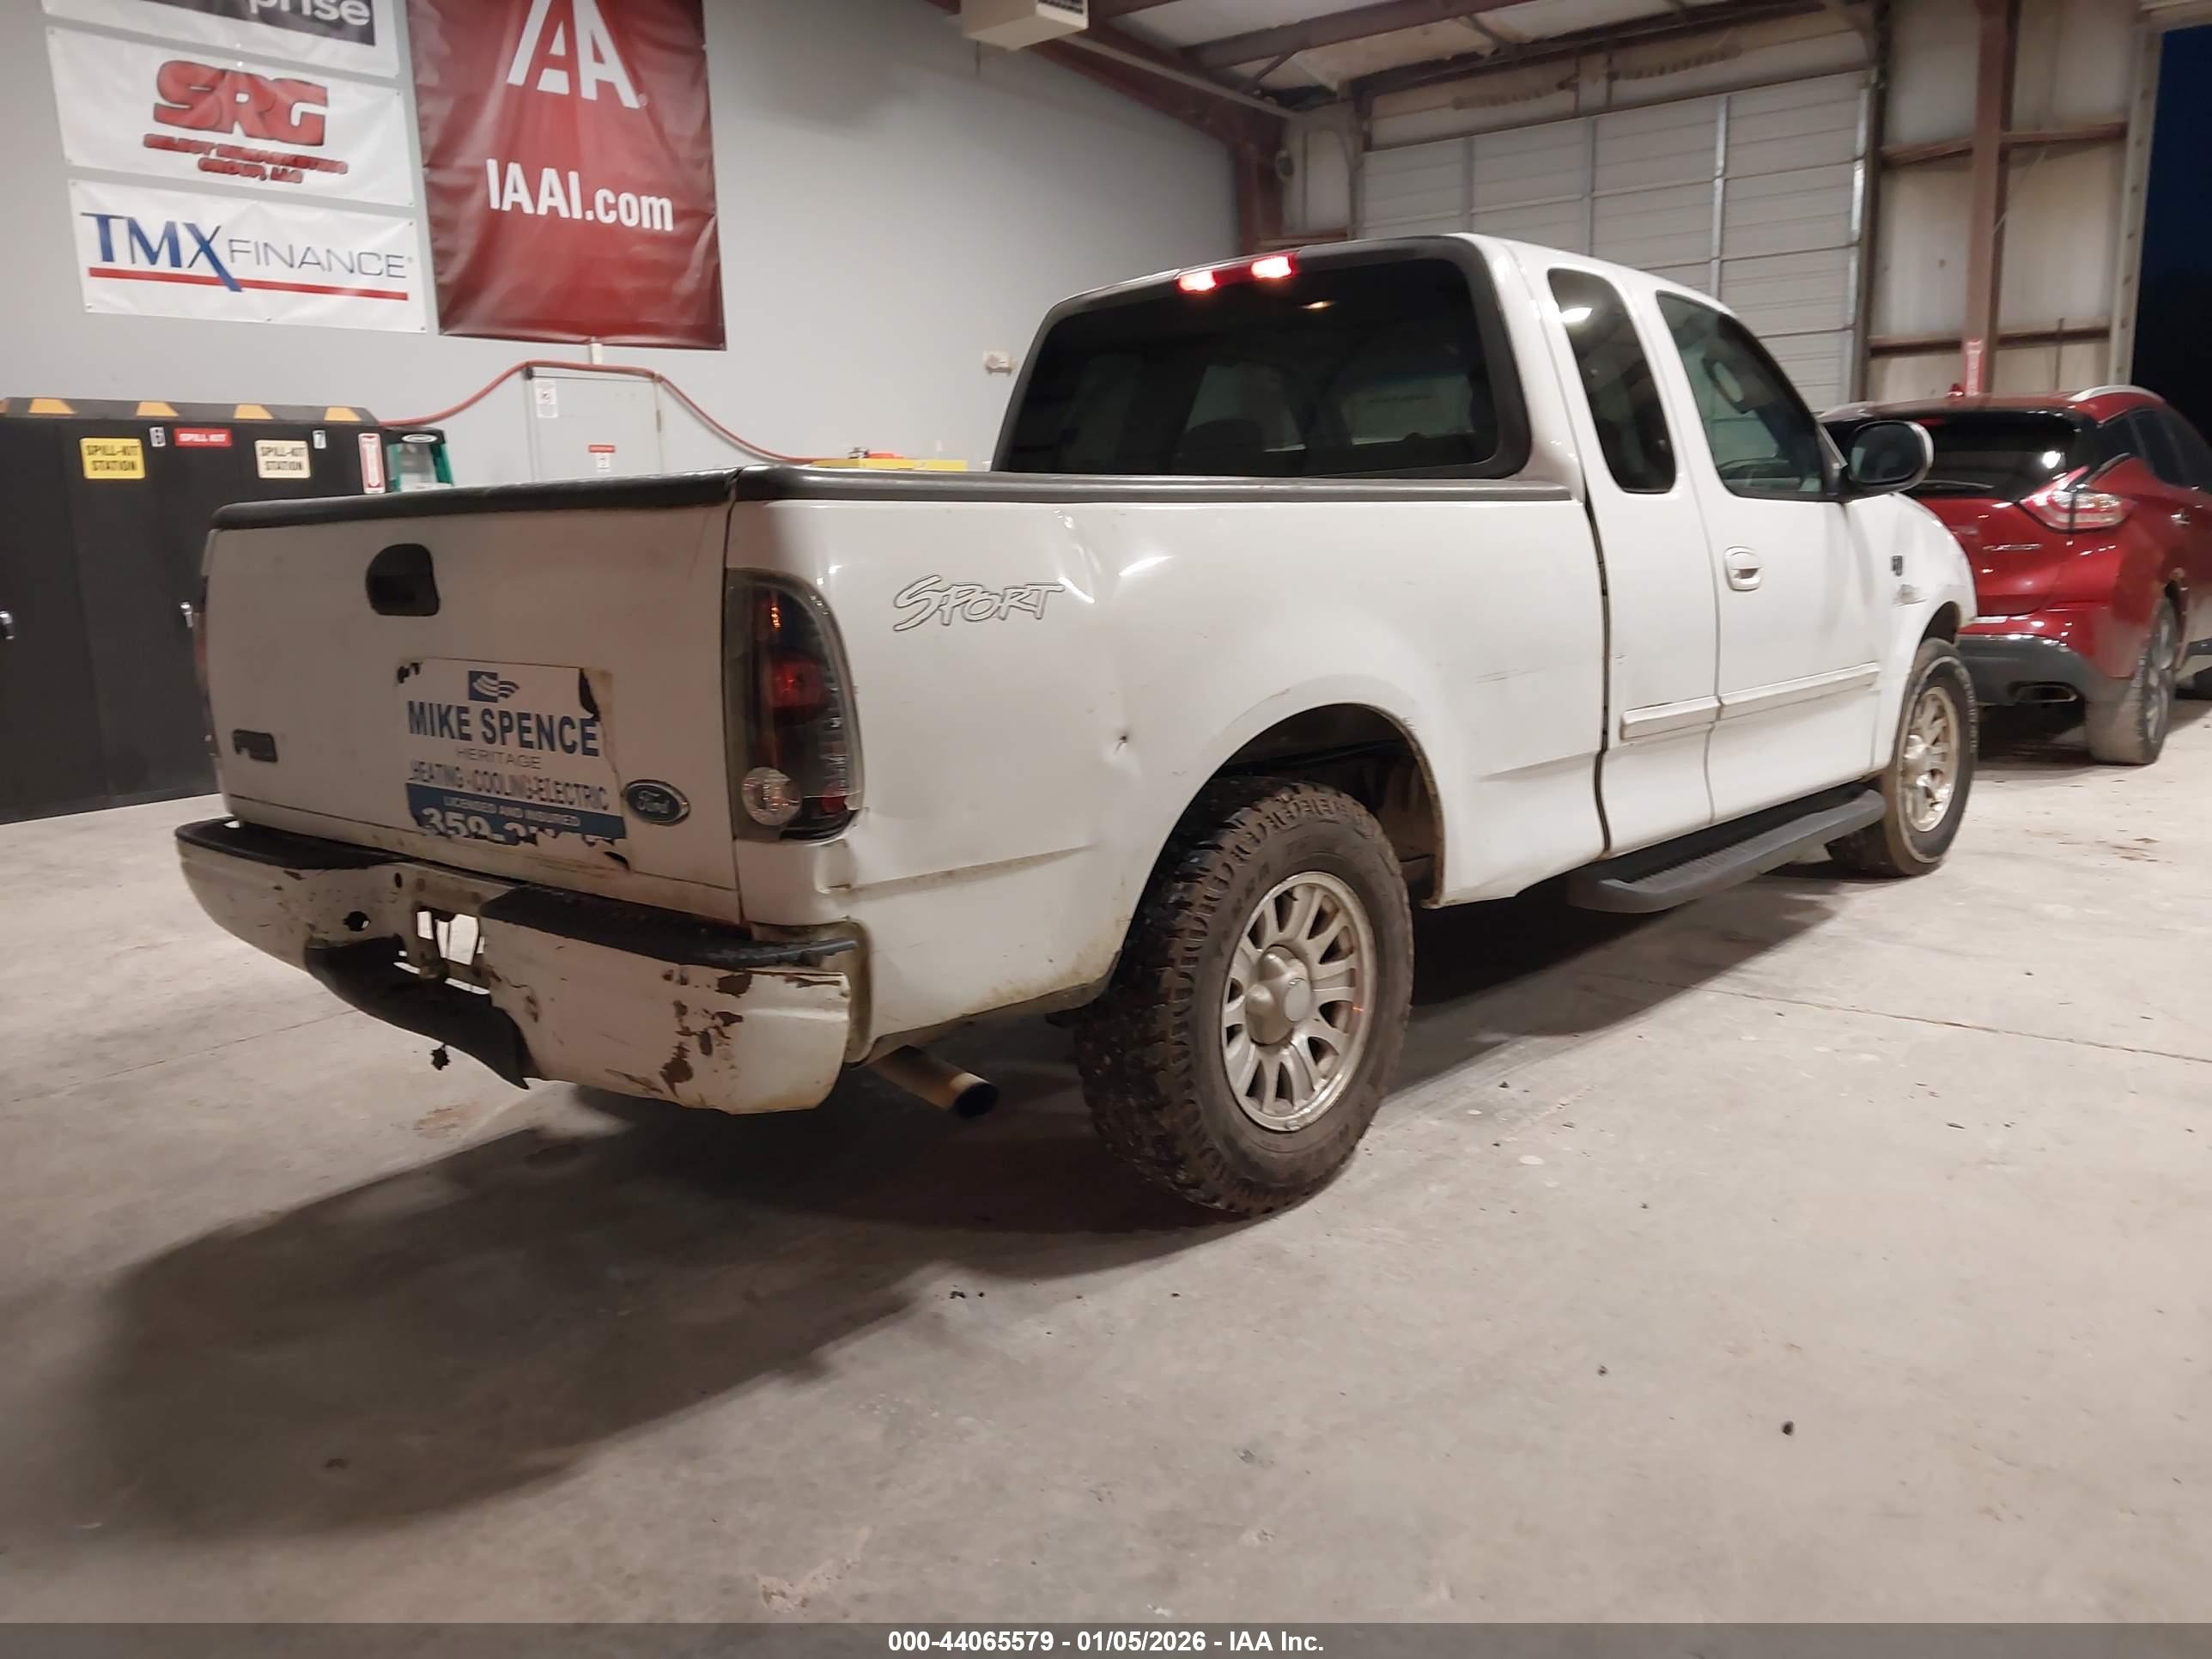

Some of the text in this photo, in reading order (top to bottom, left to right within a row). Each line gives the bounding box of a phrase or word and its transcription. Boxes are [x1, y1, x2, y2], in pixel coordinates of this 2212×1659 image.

[154, 60, 327, 146] SRG
[486, 158, 673, 232] IAAI.com
[81, 212, 407, 292] TMX FINANCE
[92, 460, 136, 471] STATION
[408, 701, 599, 757] MIKE SPENCE
[457, 747, 542, 769] HERITAGE
